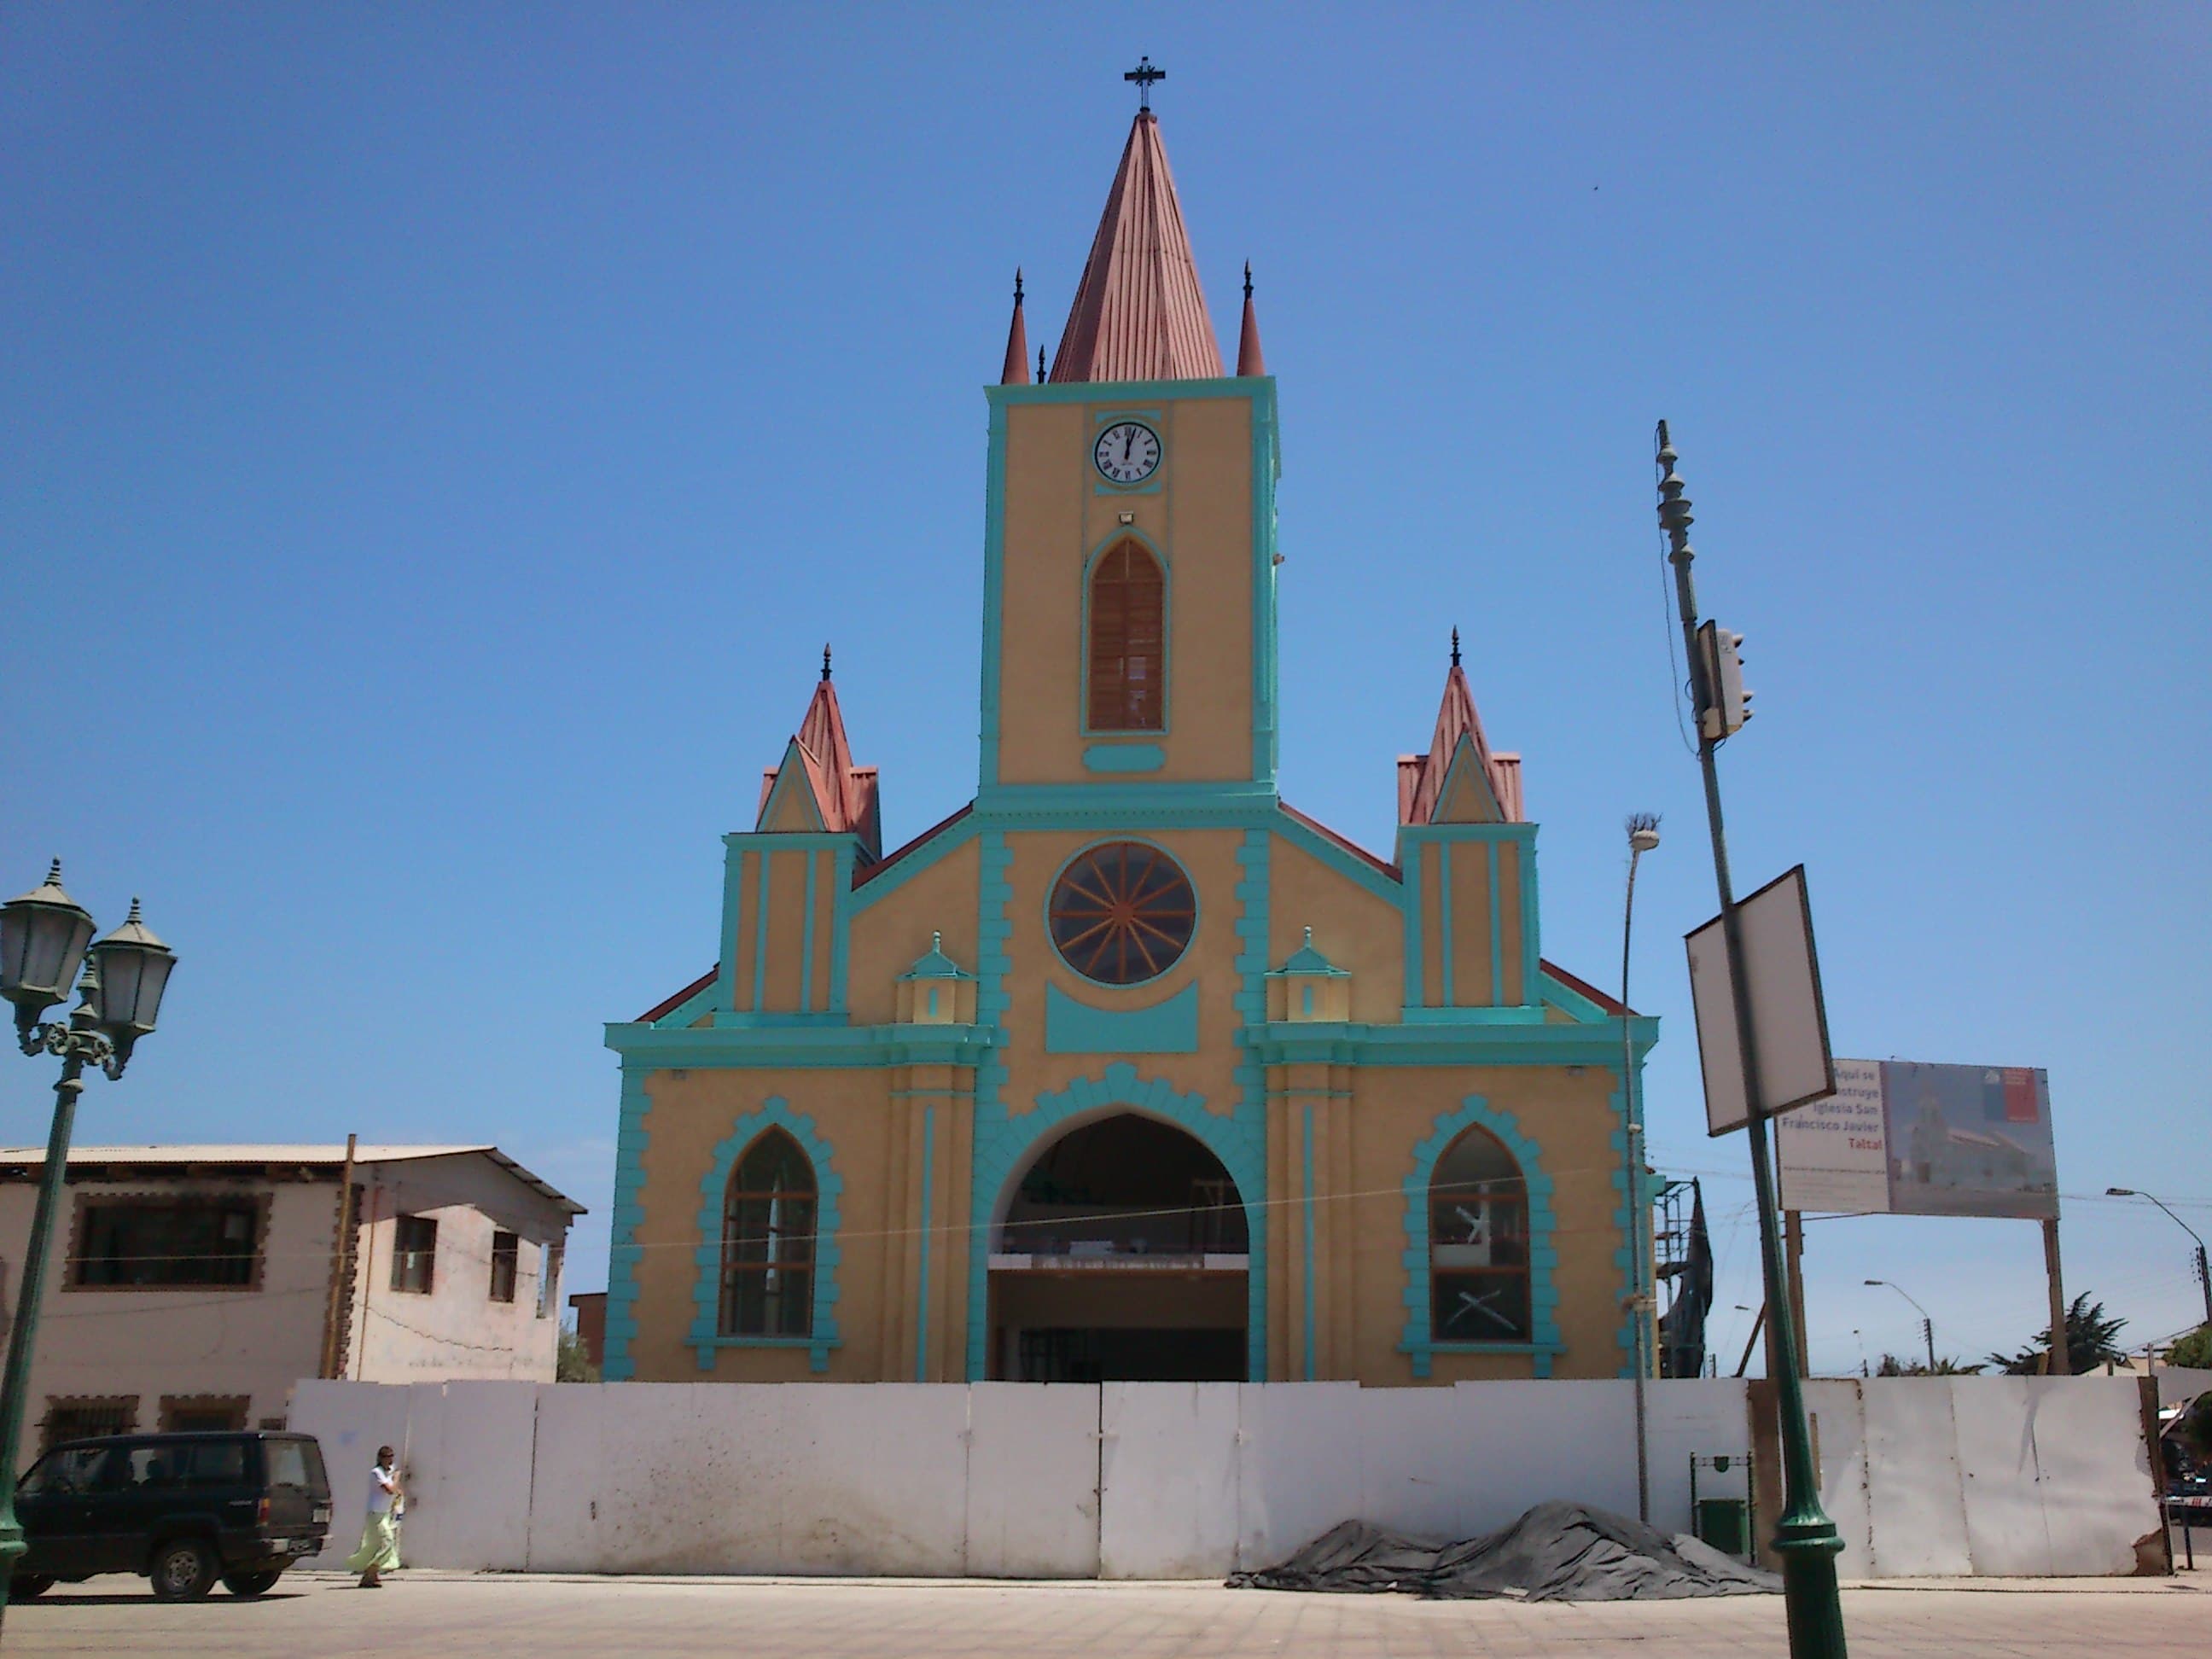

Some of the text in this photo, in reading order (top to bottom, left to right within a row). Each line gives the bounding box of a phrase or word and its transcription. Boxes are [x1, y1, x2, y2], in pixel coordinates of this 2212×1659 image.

[1863, 1071, 1875, 1080] se
[1814, 1103, 1878, 1115] Iglesia San
[1782, 1117, 1879, 1132] Francisco Javier
[1848, 1138, 1883, 1150] Taltal
